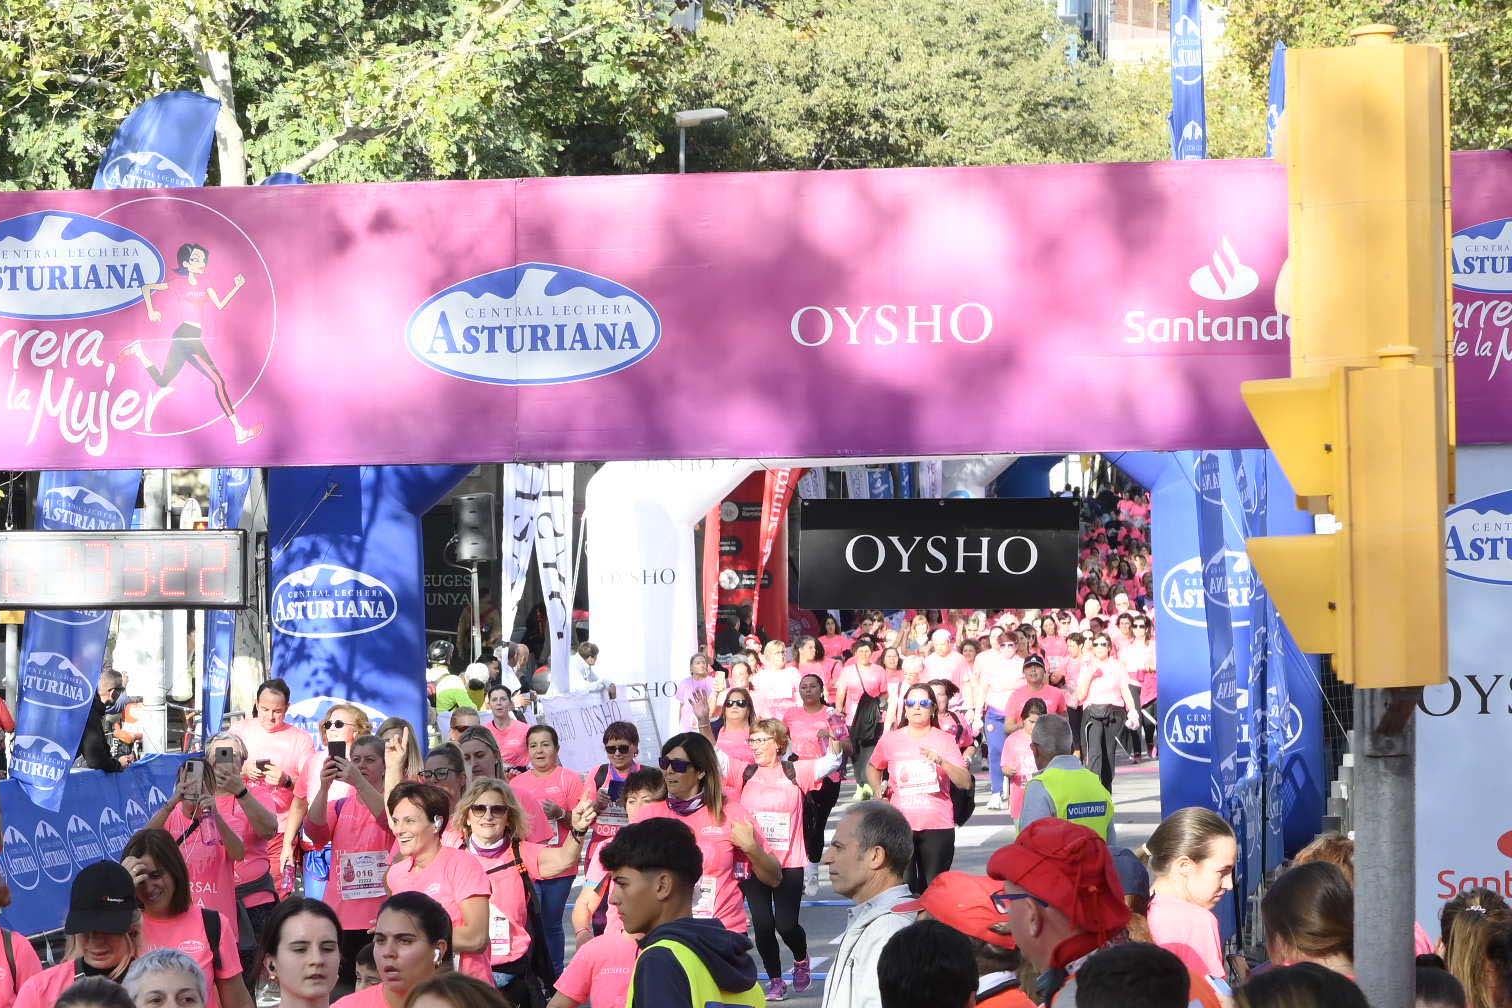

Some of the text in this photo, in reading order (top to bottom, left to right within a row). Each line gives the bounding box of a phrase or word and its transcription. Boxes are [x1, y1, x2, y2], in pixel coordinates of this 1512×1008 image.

[64, 246, 141, 259] LECHERA
[465, 303, 633, 319] CENTRAL LECHERA
[790, 301, 994, 347] OYSHO
[1123, 309, 1292, 344] Santand
[424, 309, 641, 355] ASTURIANA
[7, 372, 32, 411] la
[26, 363, 175, 456] Mujer
[845, 533, 1039, 576] OYSHO
[275, 593, 388, 622] ASTURIANA
[288, 589, 384, 599] CENTRAL LECHERA
[1417, 673, 1512, 718] OY
